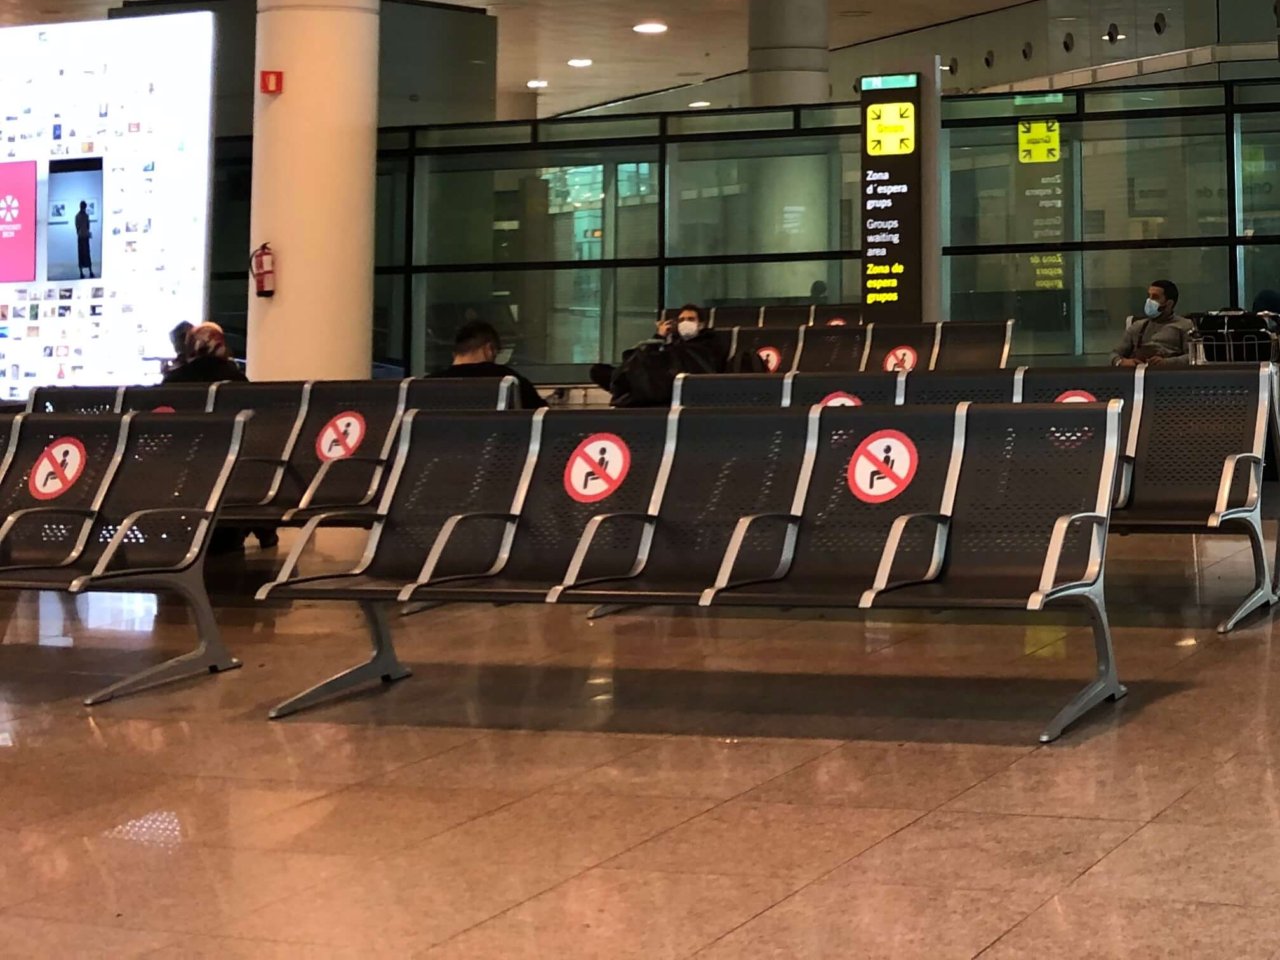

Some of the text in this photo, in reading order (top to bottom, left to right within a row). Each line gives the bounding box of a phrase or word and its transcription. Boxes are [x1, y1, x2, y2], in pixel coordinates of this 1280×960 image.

[866, 170, 889, 181] Zona
[866, 199, 892, 210] grups
[866, 218, 899, 230] Groups
[866, 231, 900, 244] waiting
[866, 247, 887, 257] area
[866, 262, 904, 275] Zona de
[866, 278, 898, 289] espera
[866, 292, 899, 304] grupos
